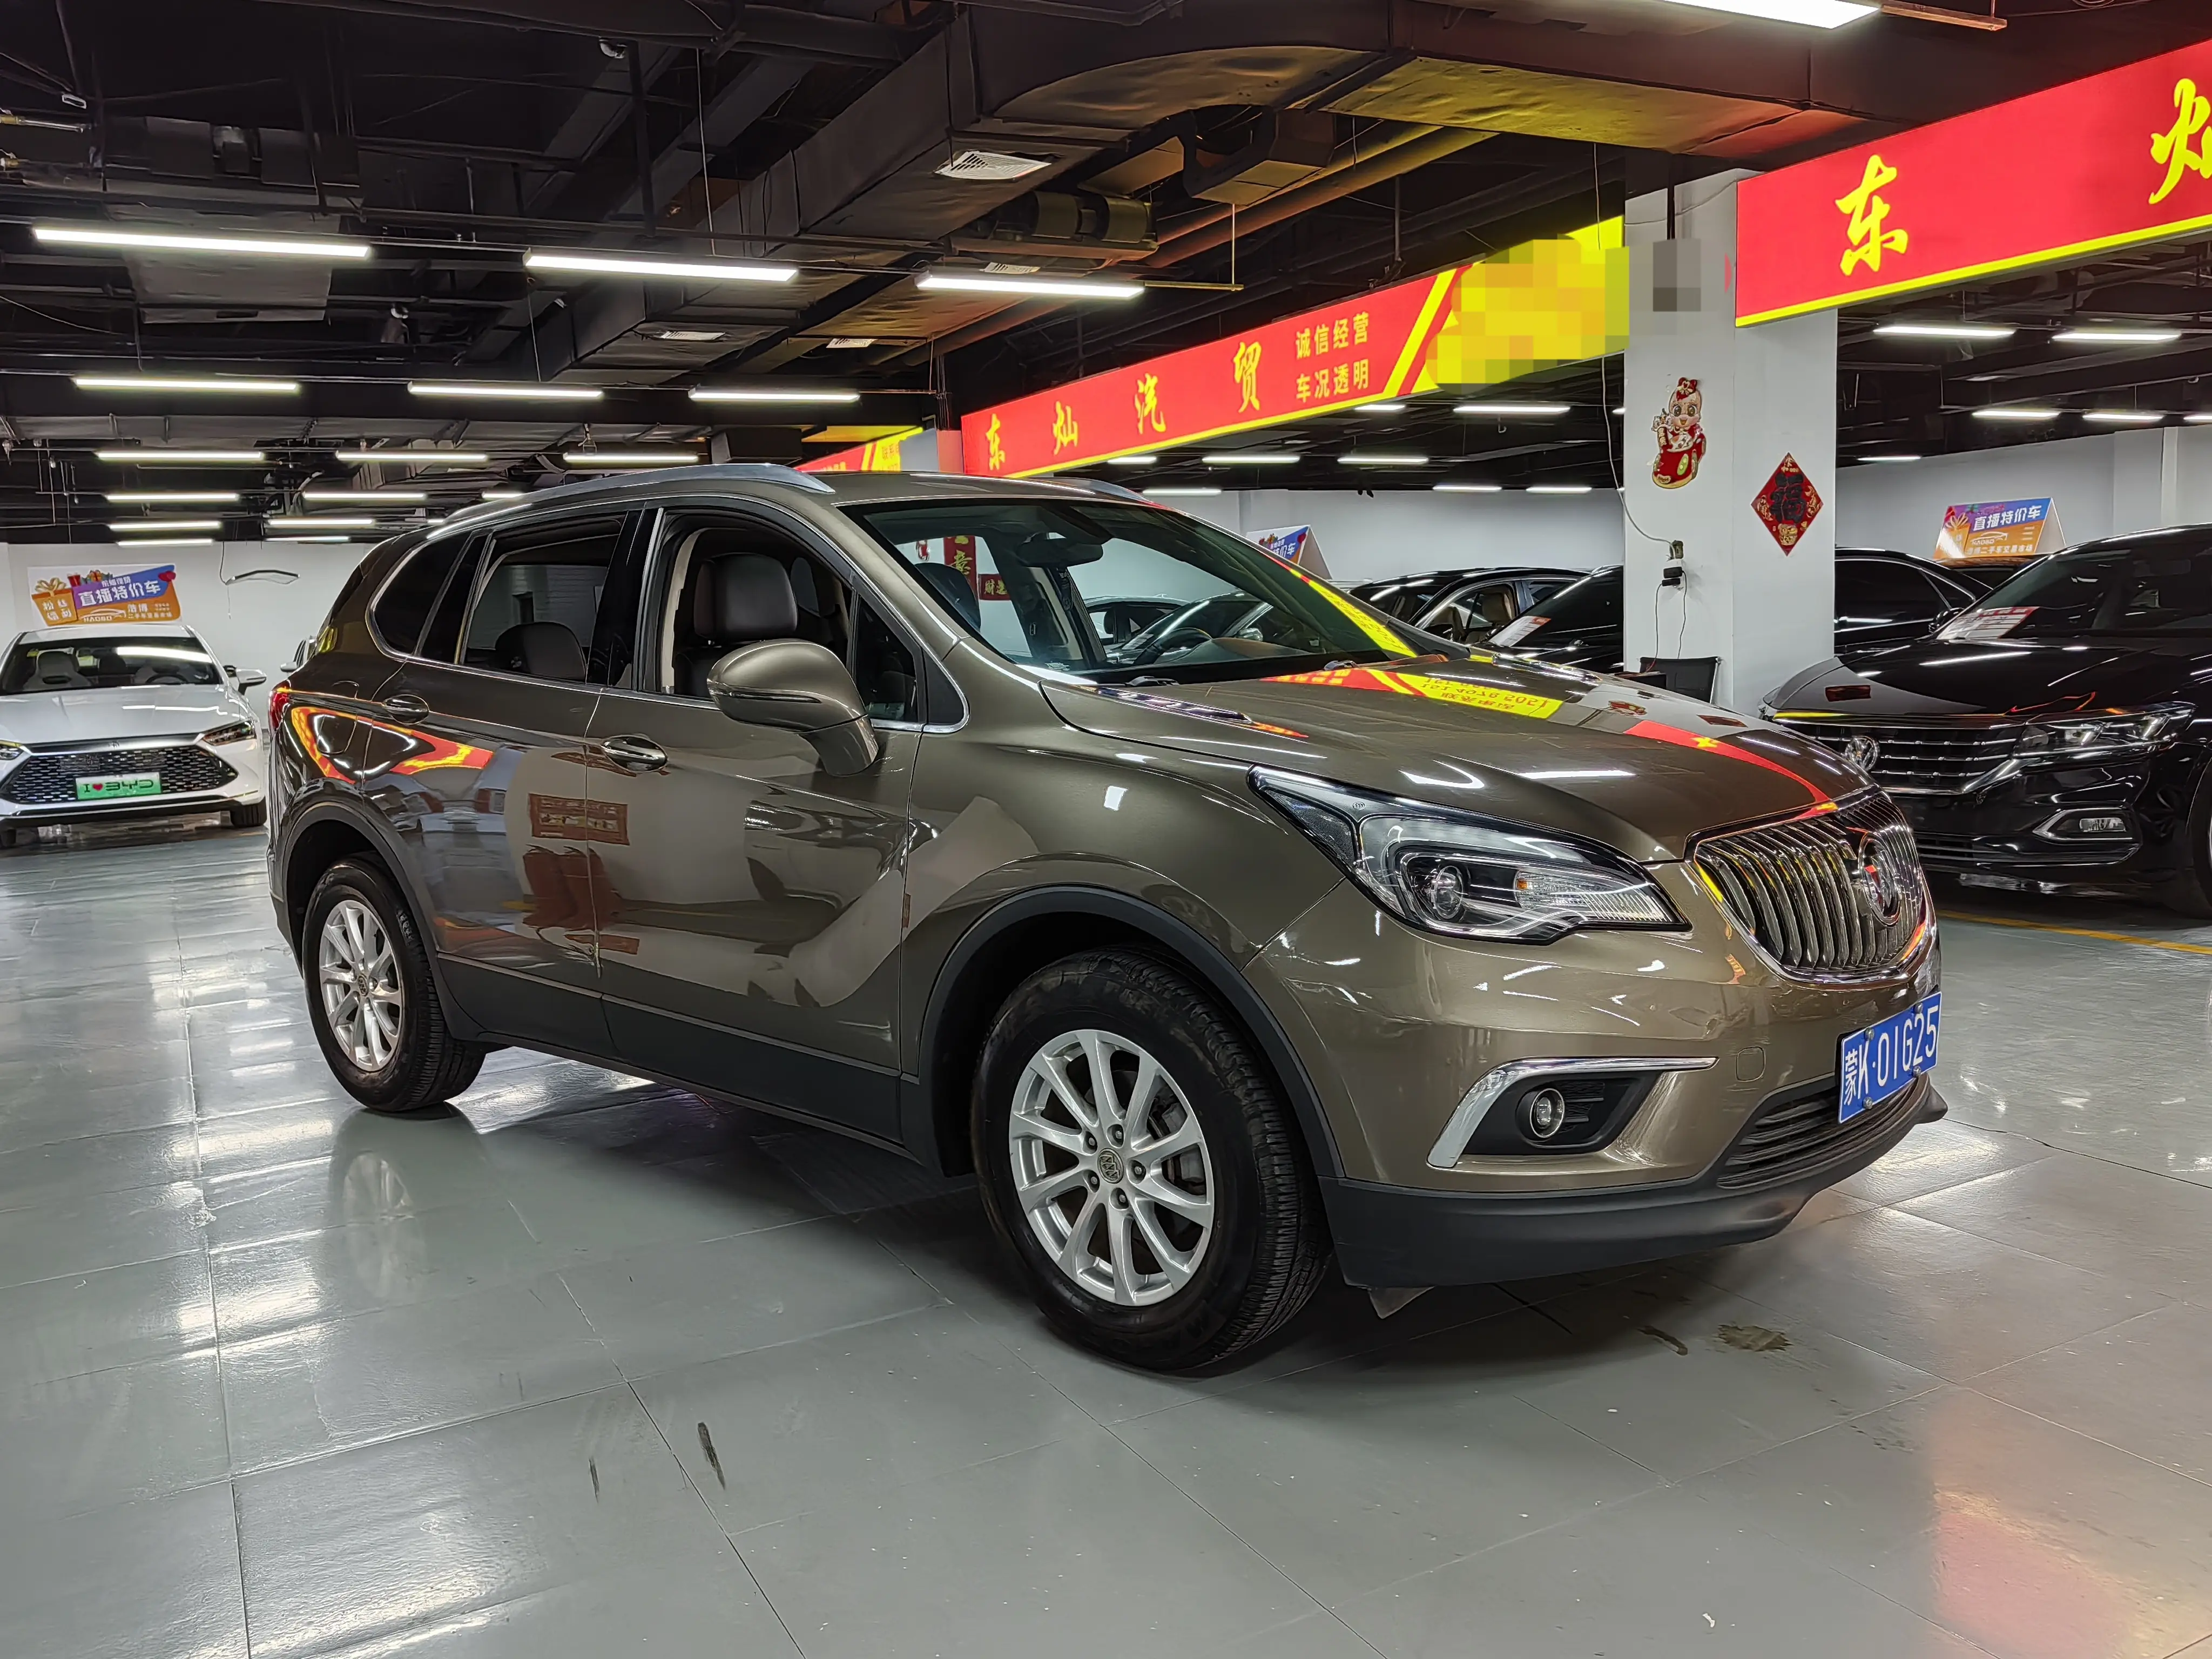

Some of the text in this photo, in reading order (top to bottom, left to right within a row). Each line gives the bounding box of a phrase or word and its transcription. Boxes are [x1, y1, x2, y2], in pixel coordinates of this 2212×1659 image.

[1296, 311, 1369, 359] 诚信经营
[1296, 359, 1369, 403] 车况透明
[986, 341, 1262, 470] 东灿汽贸
[1973, 505, 2042, 531] 直播特价车
[78, 581, 161, 607] 直播特价车
[105, 779, 154, 791] BYD
